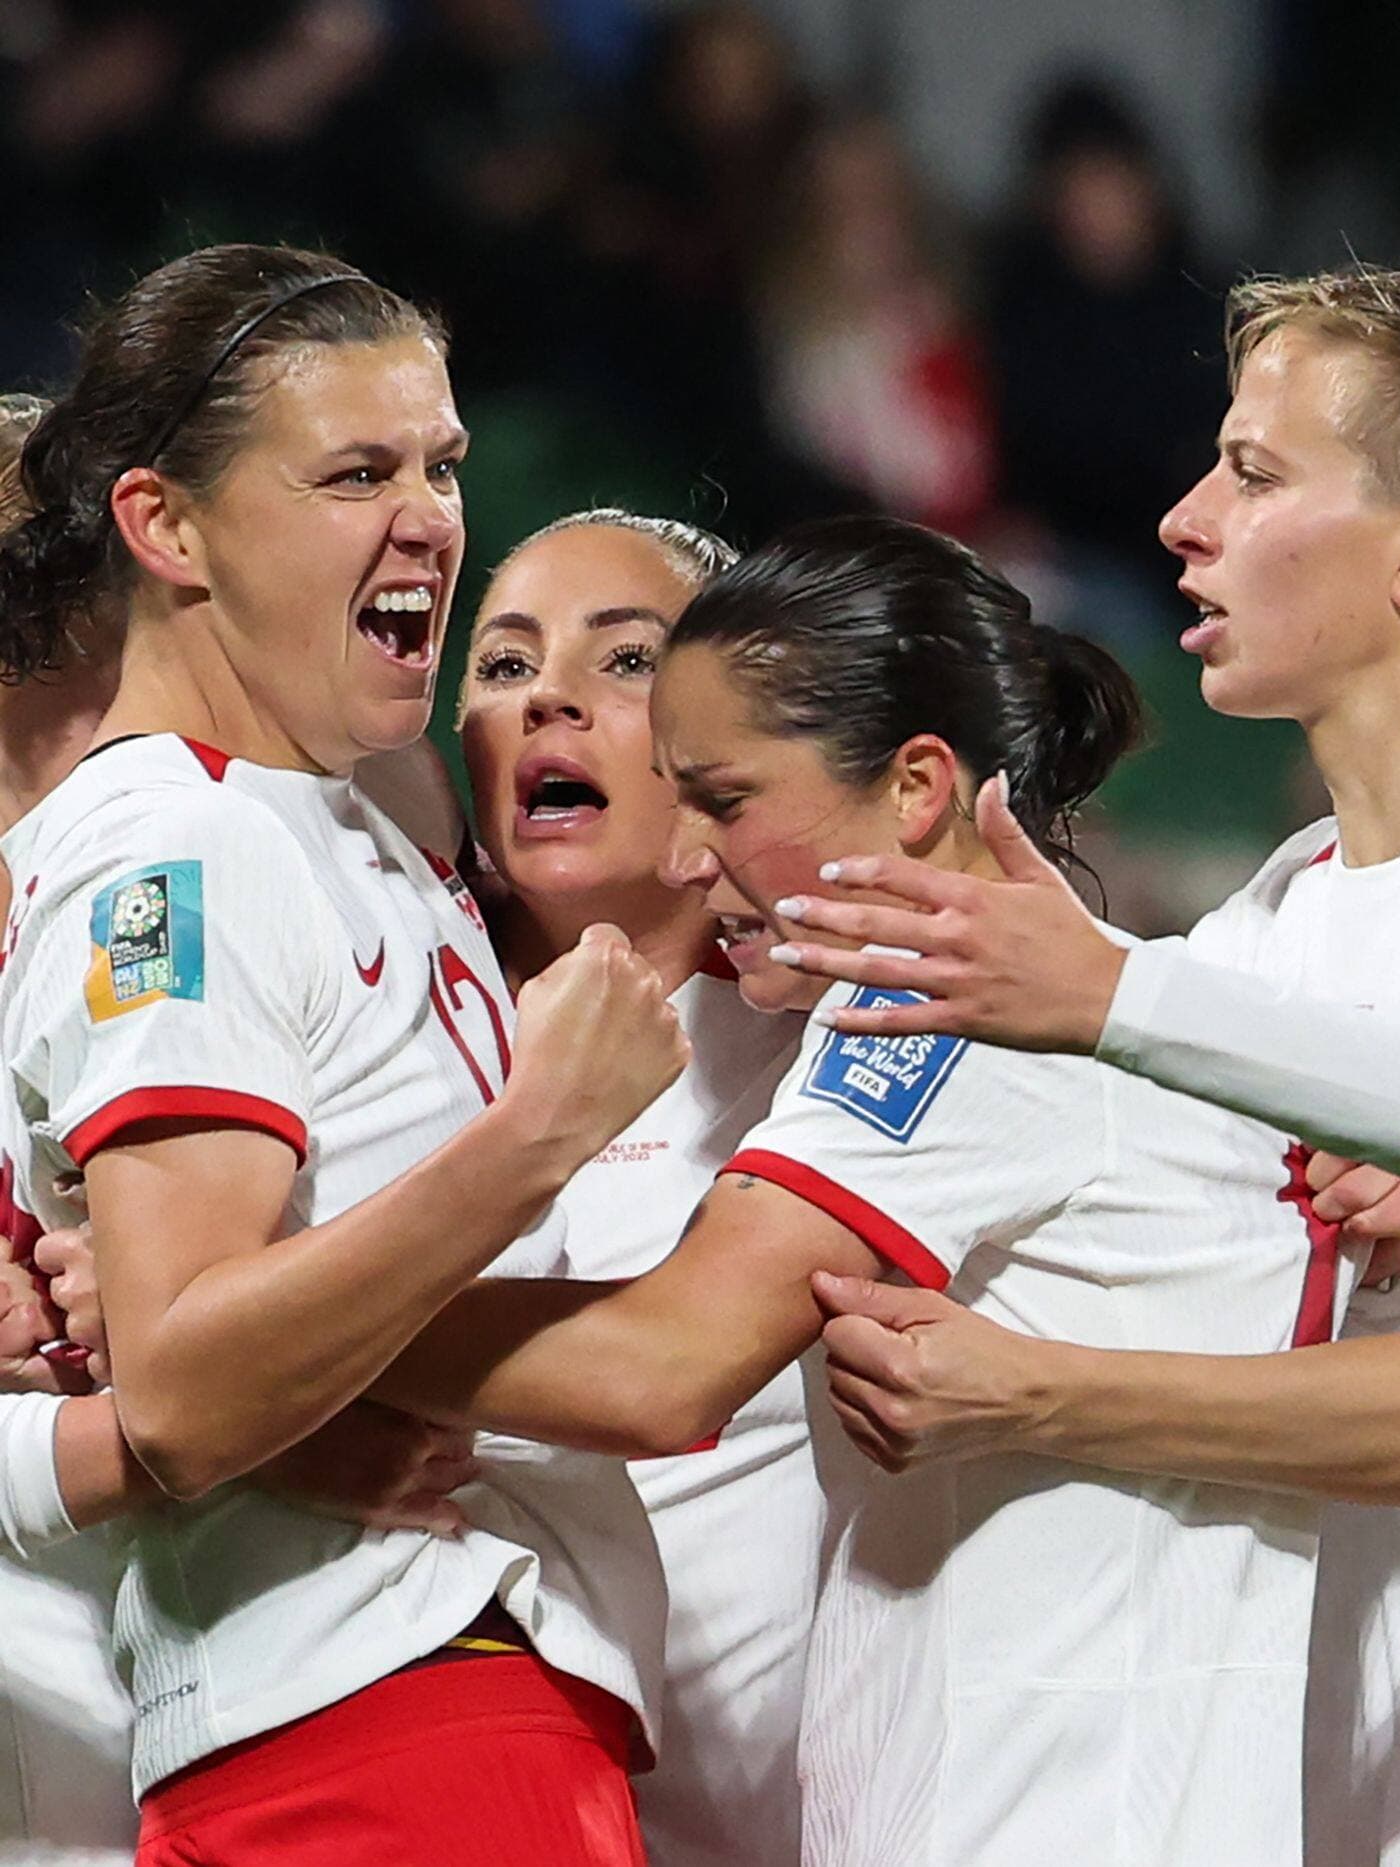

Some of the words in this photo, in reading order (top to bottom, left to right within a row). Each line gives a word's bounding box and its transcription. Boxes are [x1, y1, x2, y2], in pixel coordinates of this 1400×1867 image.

[839, 1036, 869, 1059] the
[866, 1048, 923, 1090] World
[851, 1070, 881, 1093] FIFA
